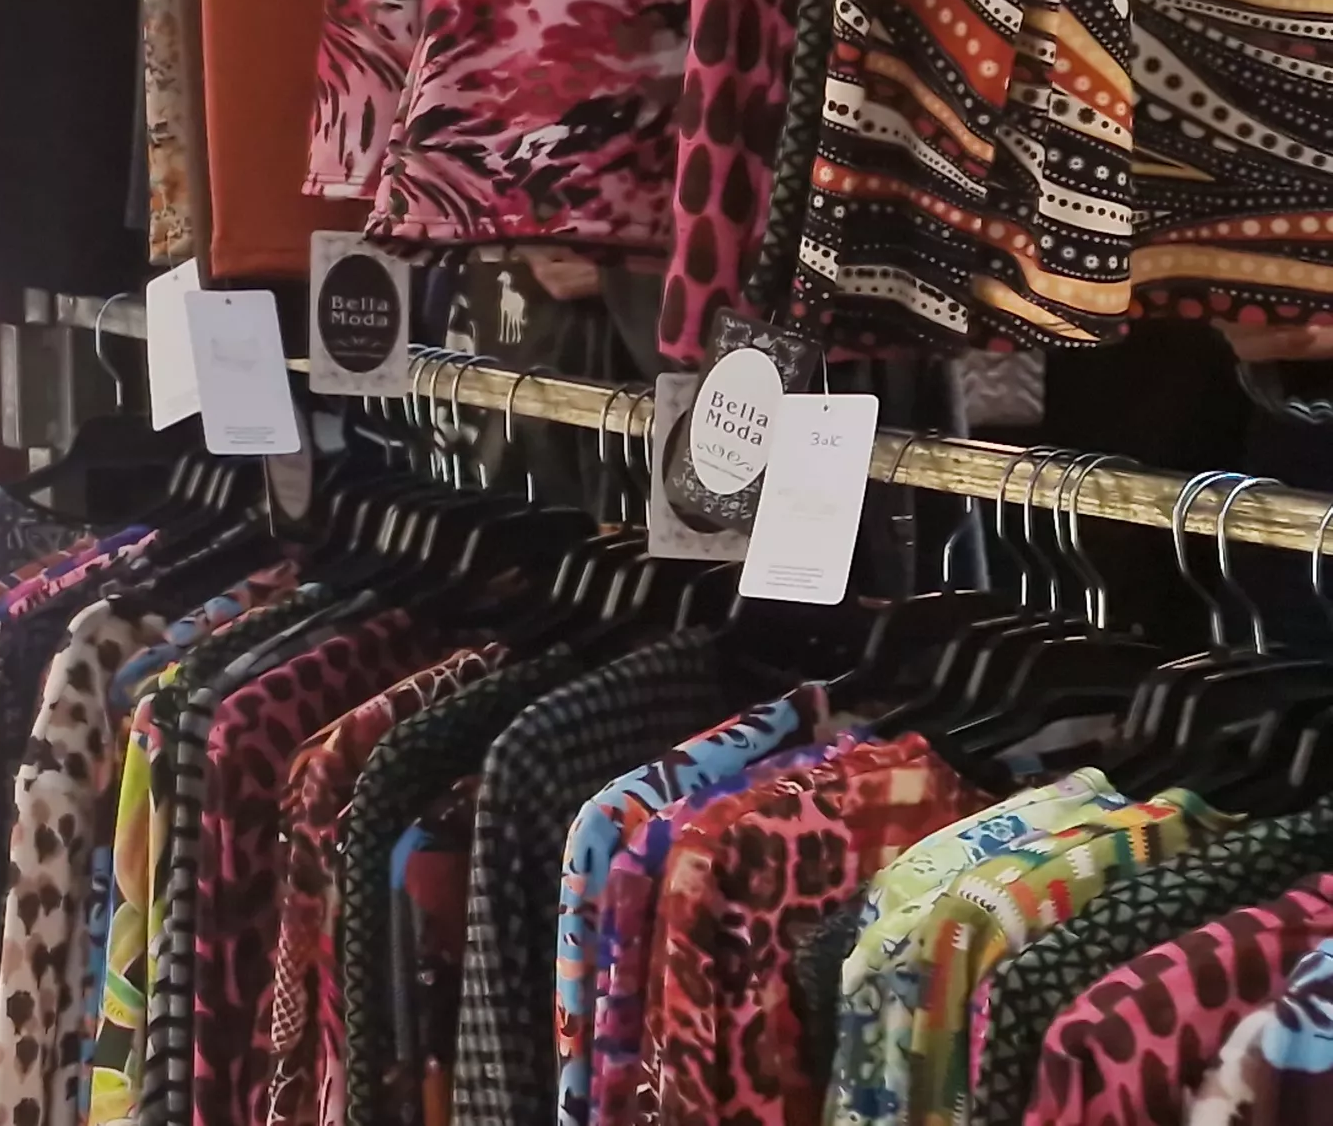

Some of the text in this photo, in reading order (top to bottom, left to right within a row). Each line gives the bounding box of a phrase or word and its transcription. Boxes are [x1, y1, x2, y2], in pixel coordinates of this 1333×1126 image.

[331, 295, 389, 311] Bella
[331, 313, 388, 327] Moda
[711, 391, 769, 428] Bella
[706, 408, 763, 446] Moda
